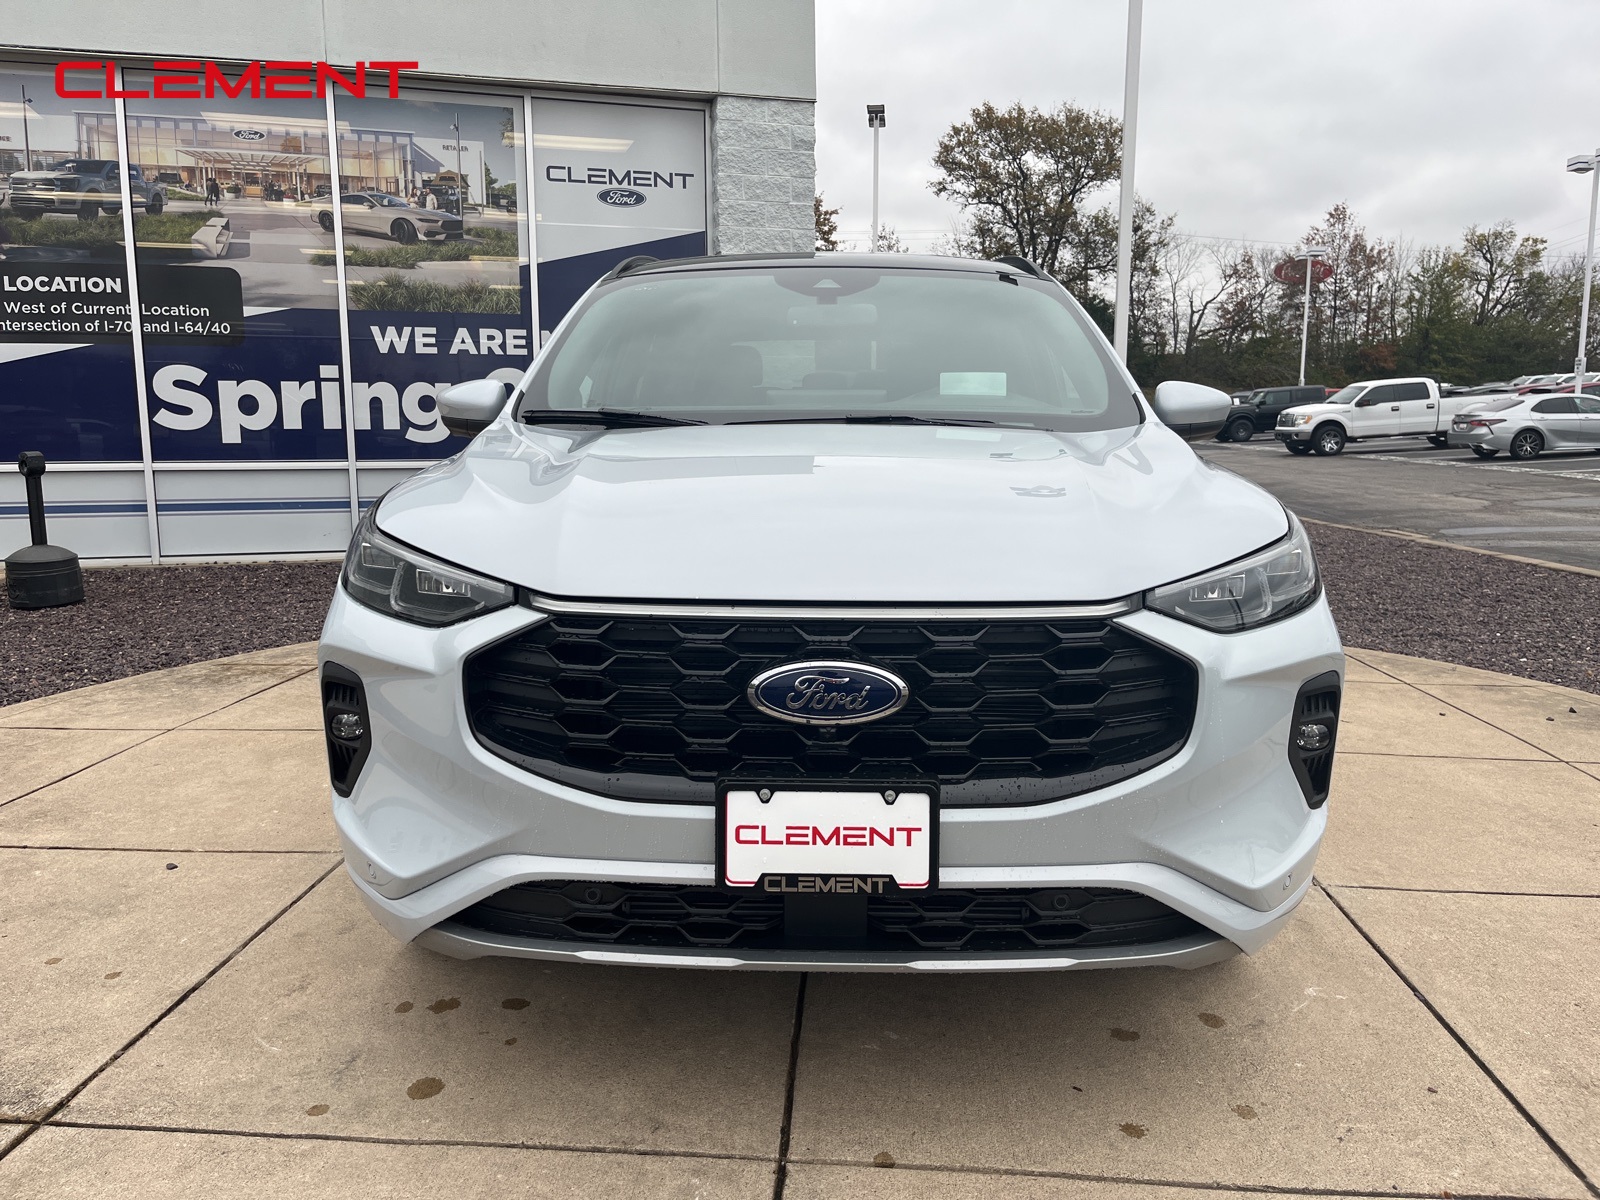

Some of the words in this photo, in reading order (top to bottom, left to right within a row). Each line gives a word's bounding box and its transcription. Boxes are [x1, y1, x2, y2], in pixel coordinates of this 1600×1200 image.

[239, 130, 261, 140] Ford
[442, 144, 469, 152] RETAER
[546, 165, 694, 190] CLEMENT
[606, 190, 637, 206] Ford
[3, 275, 122, 293] LOCATION
[4, 301, 46, 314] West
[50, 301, 67, 315] of
[71, 302, 131, 315] Current
[142, 303, 210, 317] Location
[84, 320, 100, 332] of
[105, 320, 133, 333] I-70
[143, 320, 170, 333] and
[174, 321, 231, 336] I-64/40
[370, 325, 439, 355] WE
[448, 327, 529, 356] ARE
[152, 363, 451, 445] Spring
[786, 674, 871, 711] Ford
[735, 824, 922, 847] CLEMENT
[763, 875, 890, 894] CLEMENT
